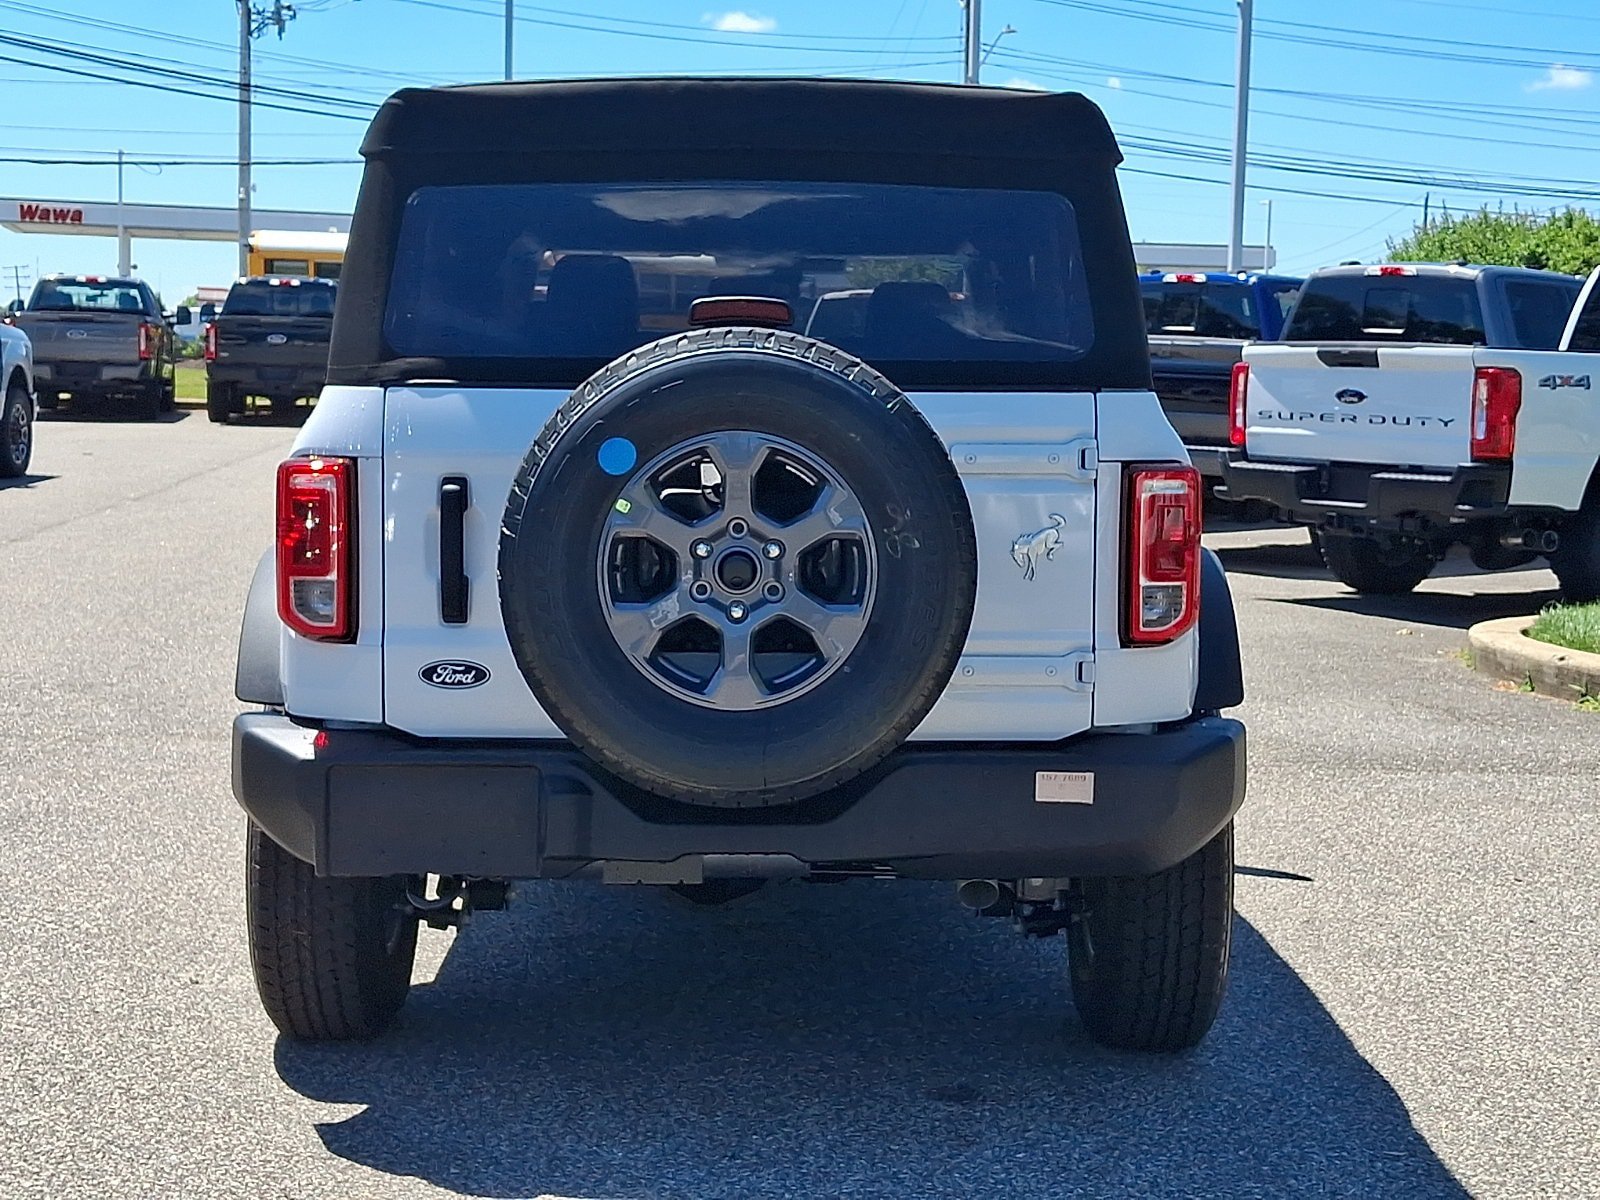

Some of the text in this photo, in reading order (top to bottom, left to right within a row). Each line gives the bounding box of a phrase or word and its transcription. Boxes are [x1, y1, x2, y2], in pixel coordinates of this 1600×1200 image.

[19, 204, 83, 223] Wawa
[1257, 410, 1456, 428] SUPER DUTY
[432, 664, 476, 683] Ford
